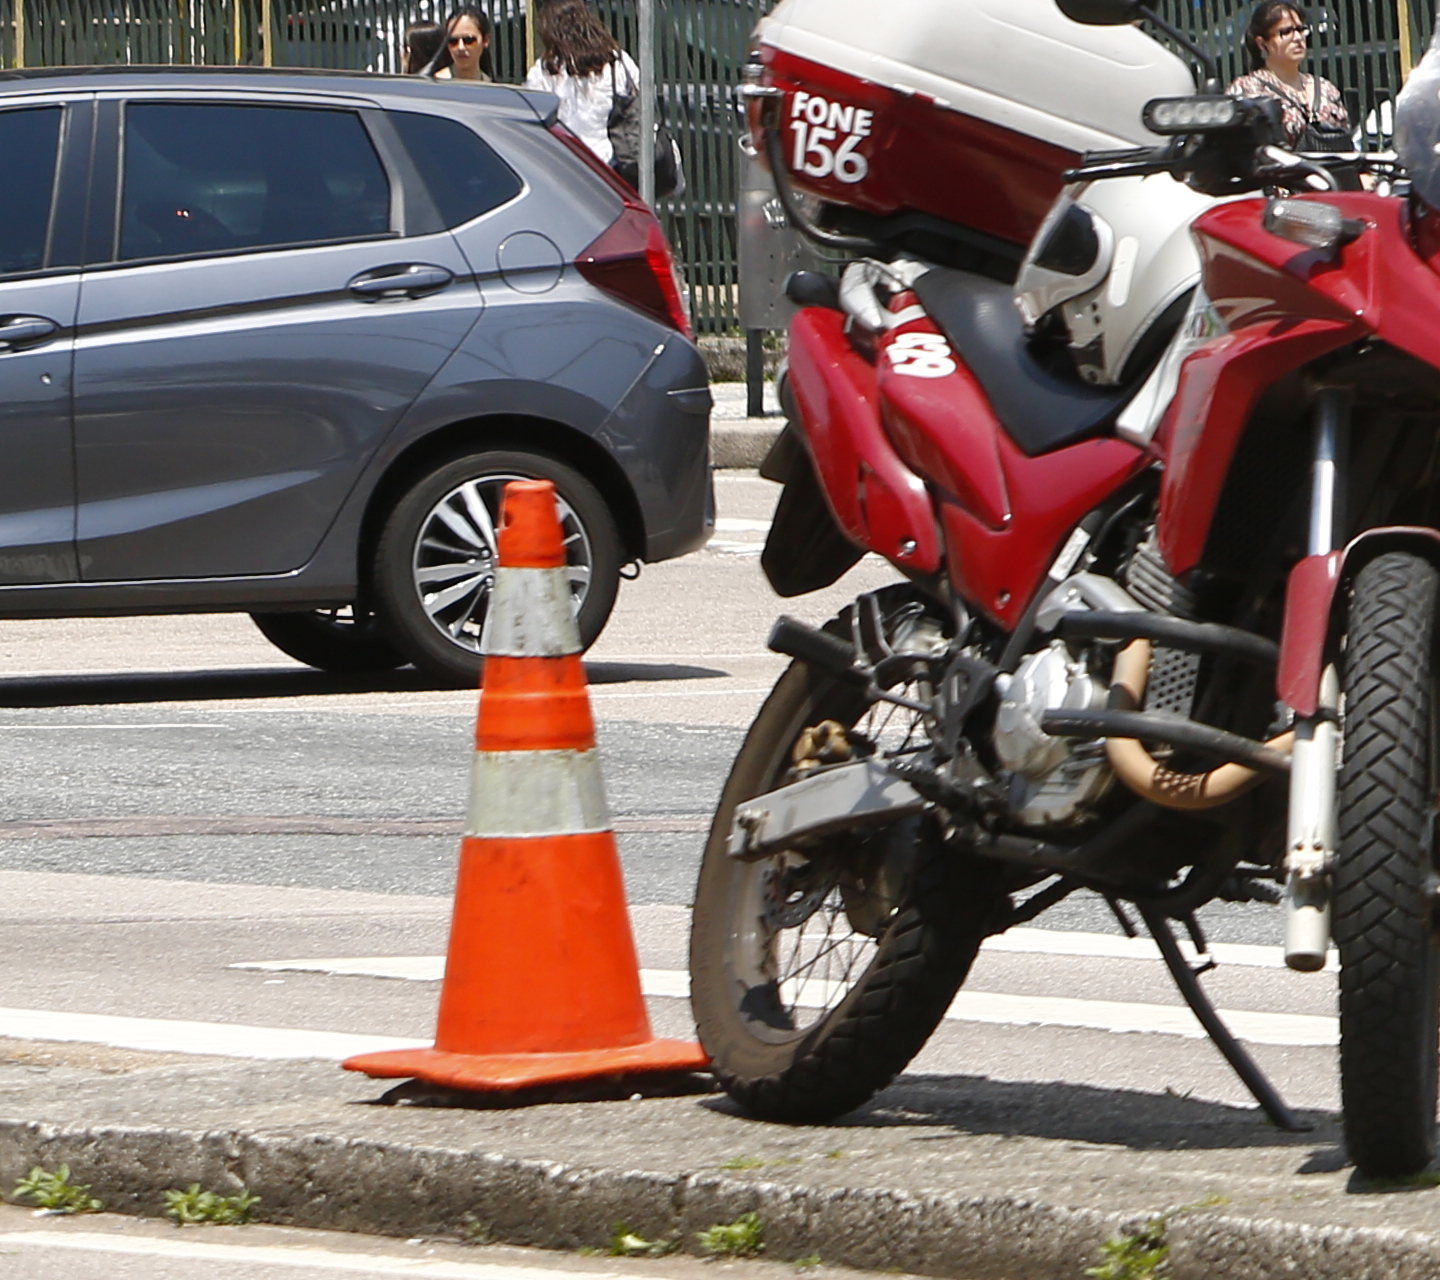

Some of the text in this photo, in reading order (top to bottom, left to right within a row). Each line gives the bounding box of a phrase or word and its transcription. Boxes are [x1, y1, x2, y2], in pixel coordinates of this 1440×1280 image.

[791, 91, 874, 136] FONE
[790, 120, 869, 184] 156
[886, 332, 957, 378] 429
